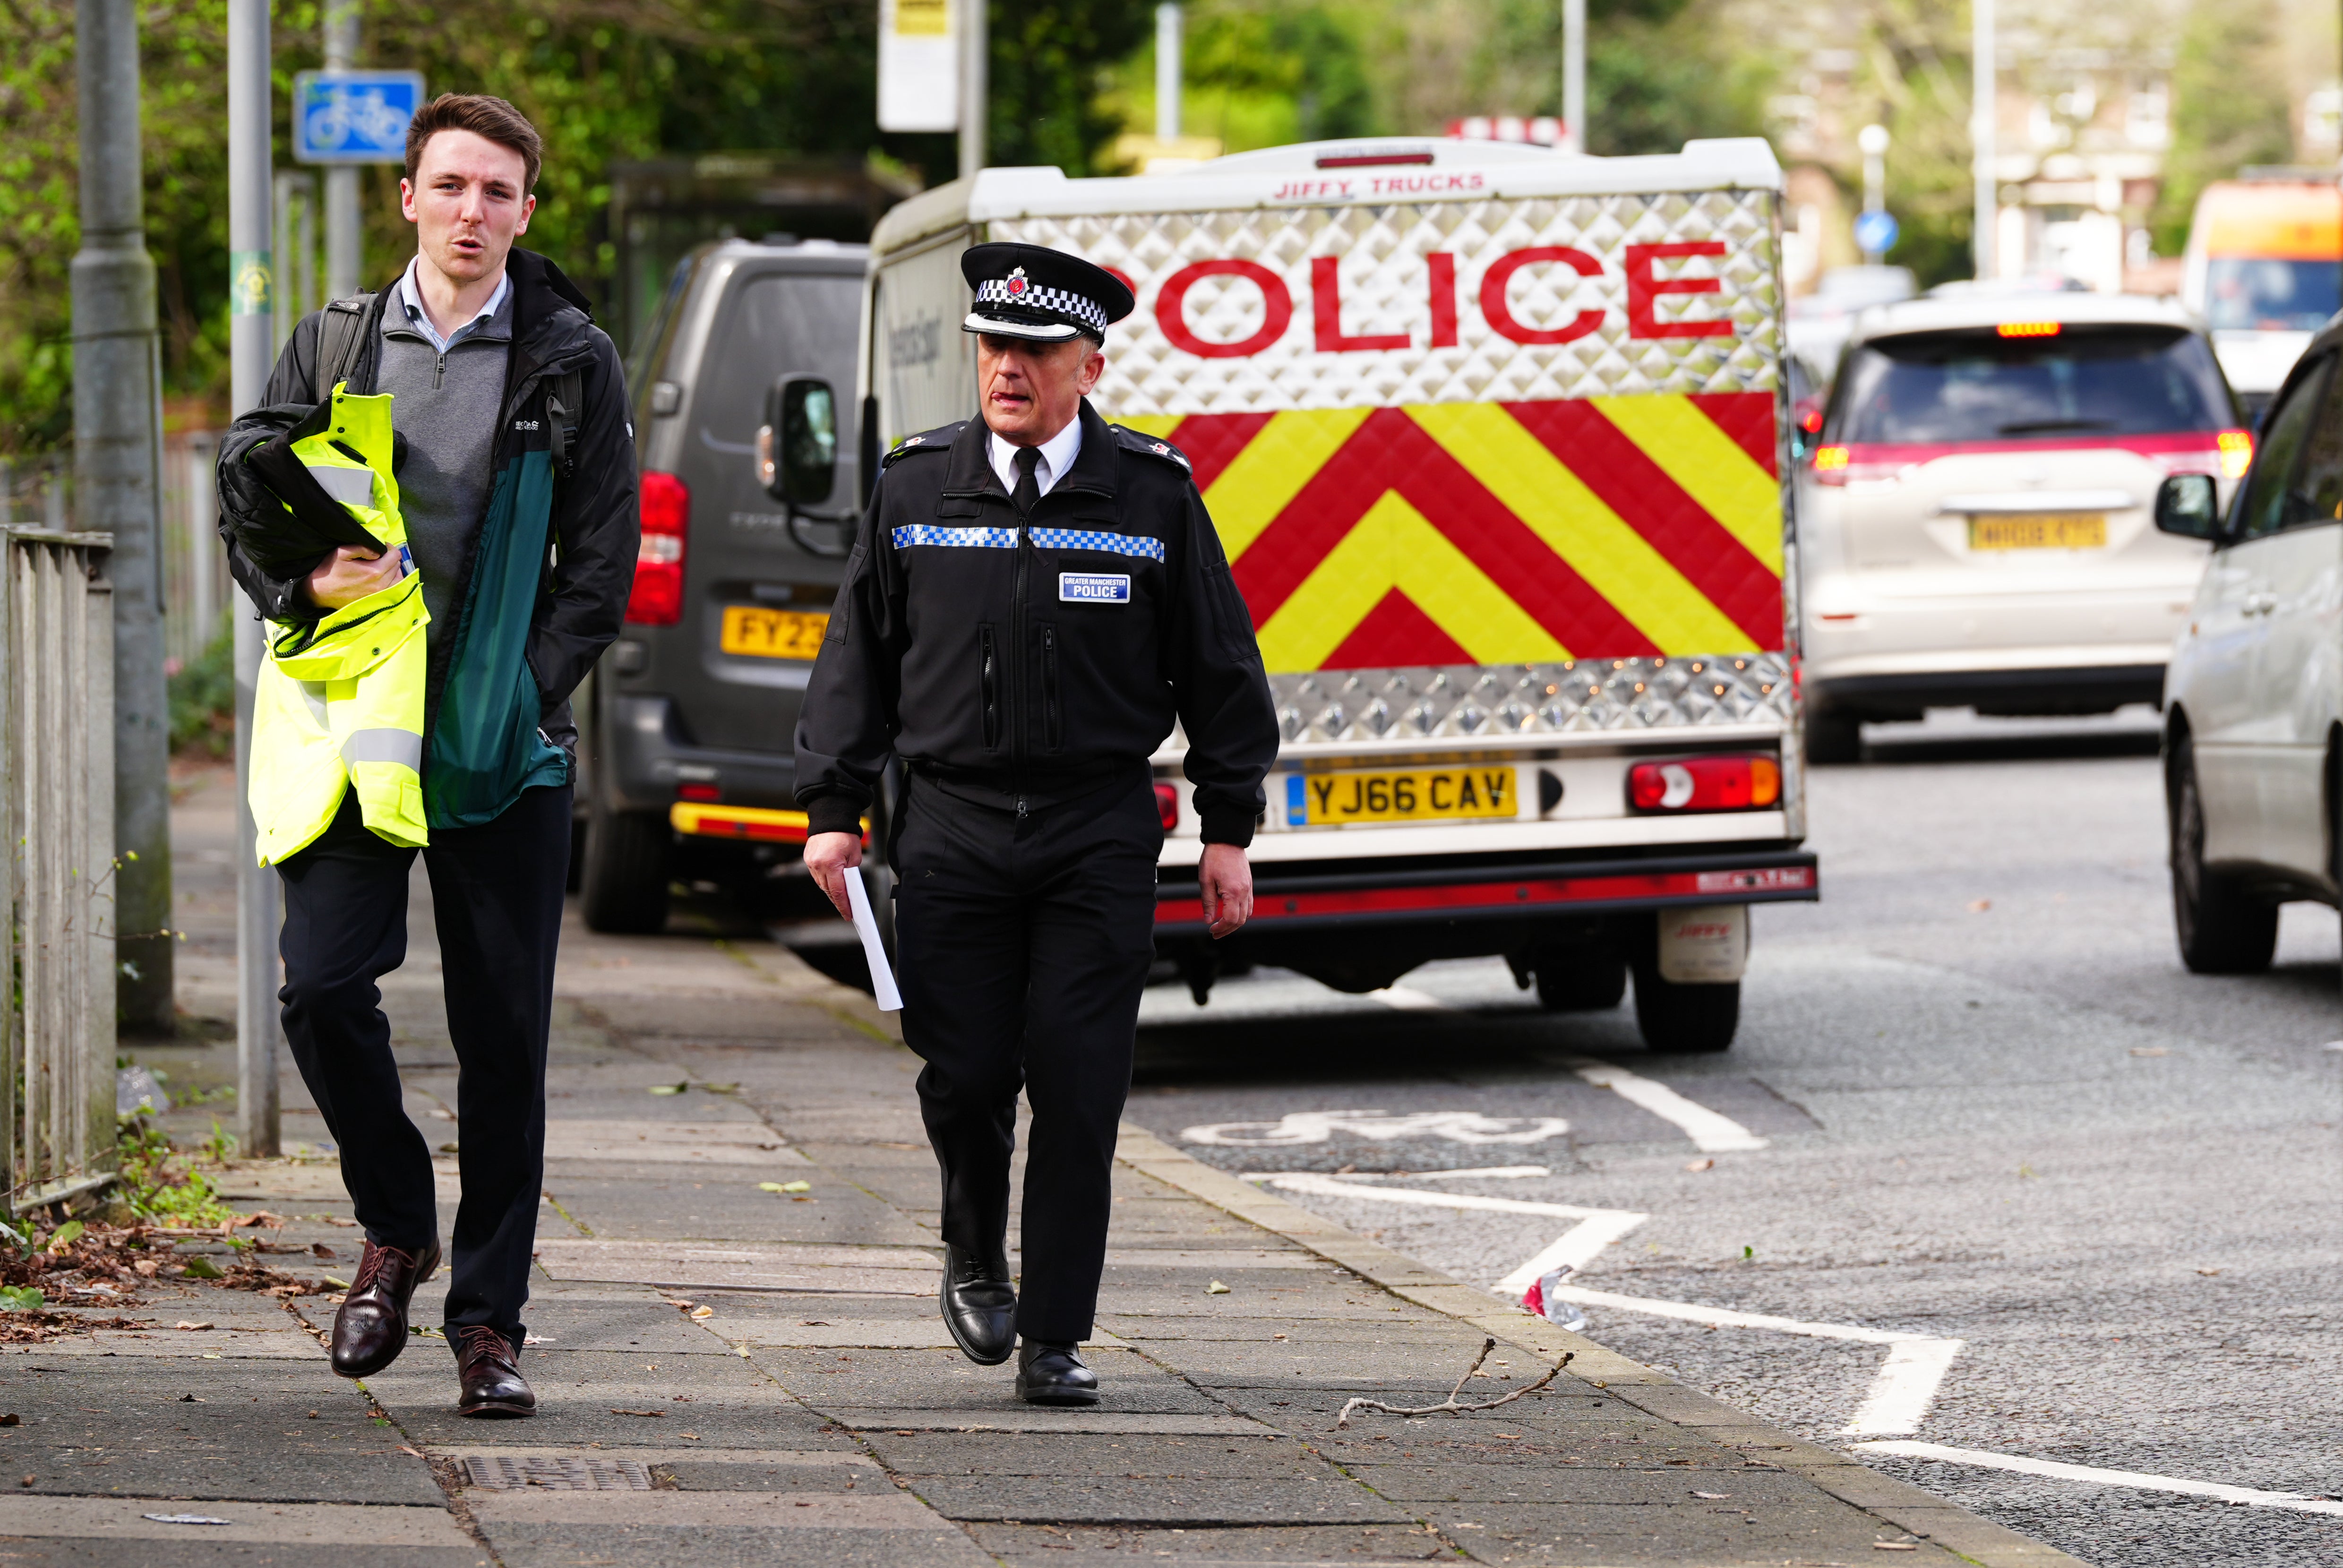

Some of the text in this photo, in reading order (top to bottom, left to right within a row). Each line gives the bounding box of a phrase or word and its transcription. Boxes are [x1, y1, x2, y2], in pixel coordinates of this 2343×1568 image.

[1274, 172, 1485, 200] JIFFY TRUCKS
[1096, 241, 1733, 358] OLICE
[1073, 585, 1117, 598] POLICE
[1089, 578, 1126, 586] MANCHESTER
[1313, 771, 1505, 815] YJ66 CAV
